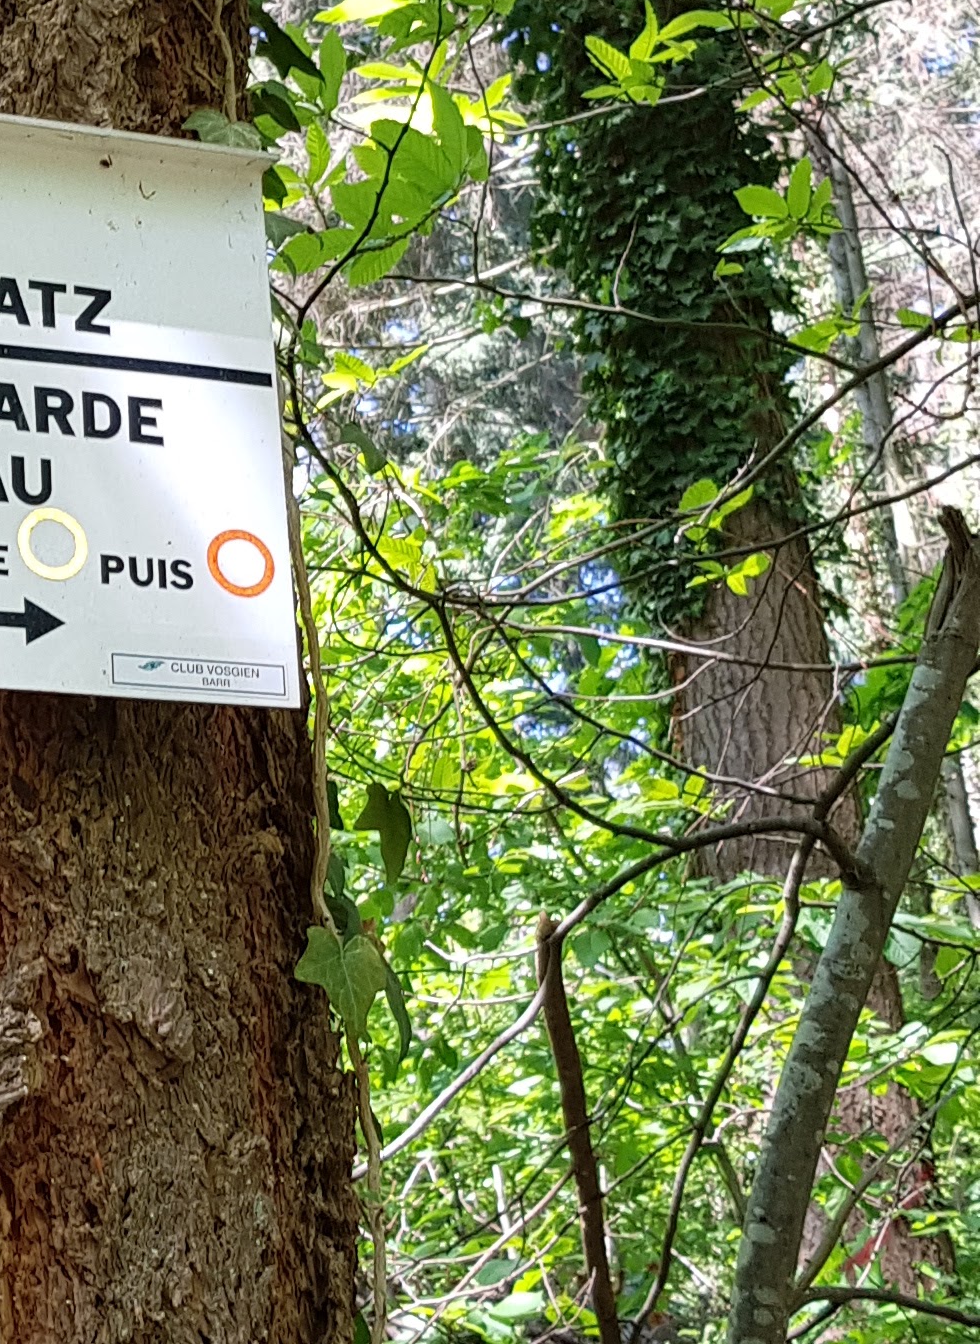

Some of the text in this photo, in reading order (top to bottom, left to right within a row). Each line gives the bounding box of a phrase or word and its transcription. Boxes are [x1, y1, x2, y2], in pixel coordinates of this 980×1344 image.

[100, 554, 194, 590] PUIS
[170, 661, 260, 679] CLUB VOSGIEN
[202, 677, 231, 688] BARR
